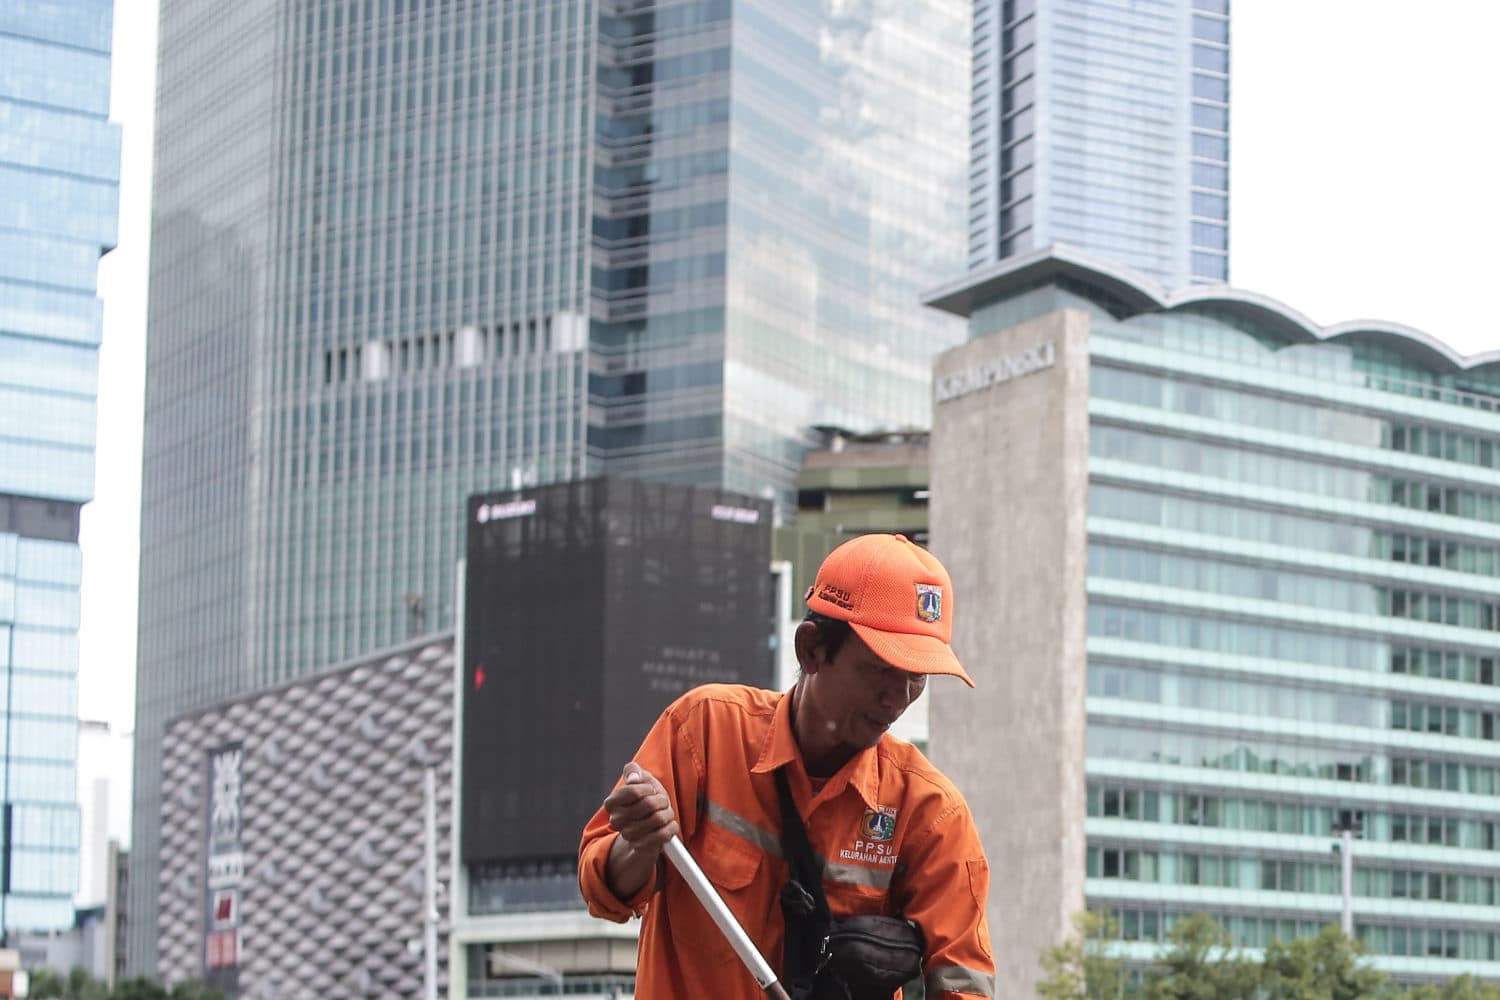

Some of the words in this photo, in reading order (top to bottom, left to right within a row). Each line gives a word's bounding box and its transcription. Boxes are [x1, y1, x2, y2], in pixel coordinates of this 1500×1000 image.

[824, 584, 851, 601] PPSU
[855, 840, 893, 855] PPSU
[840, 849, 878, 863] KELURAHAN
